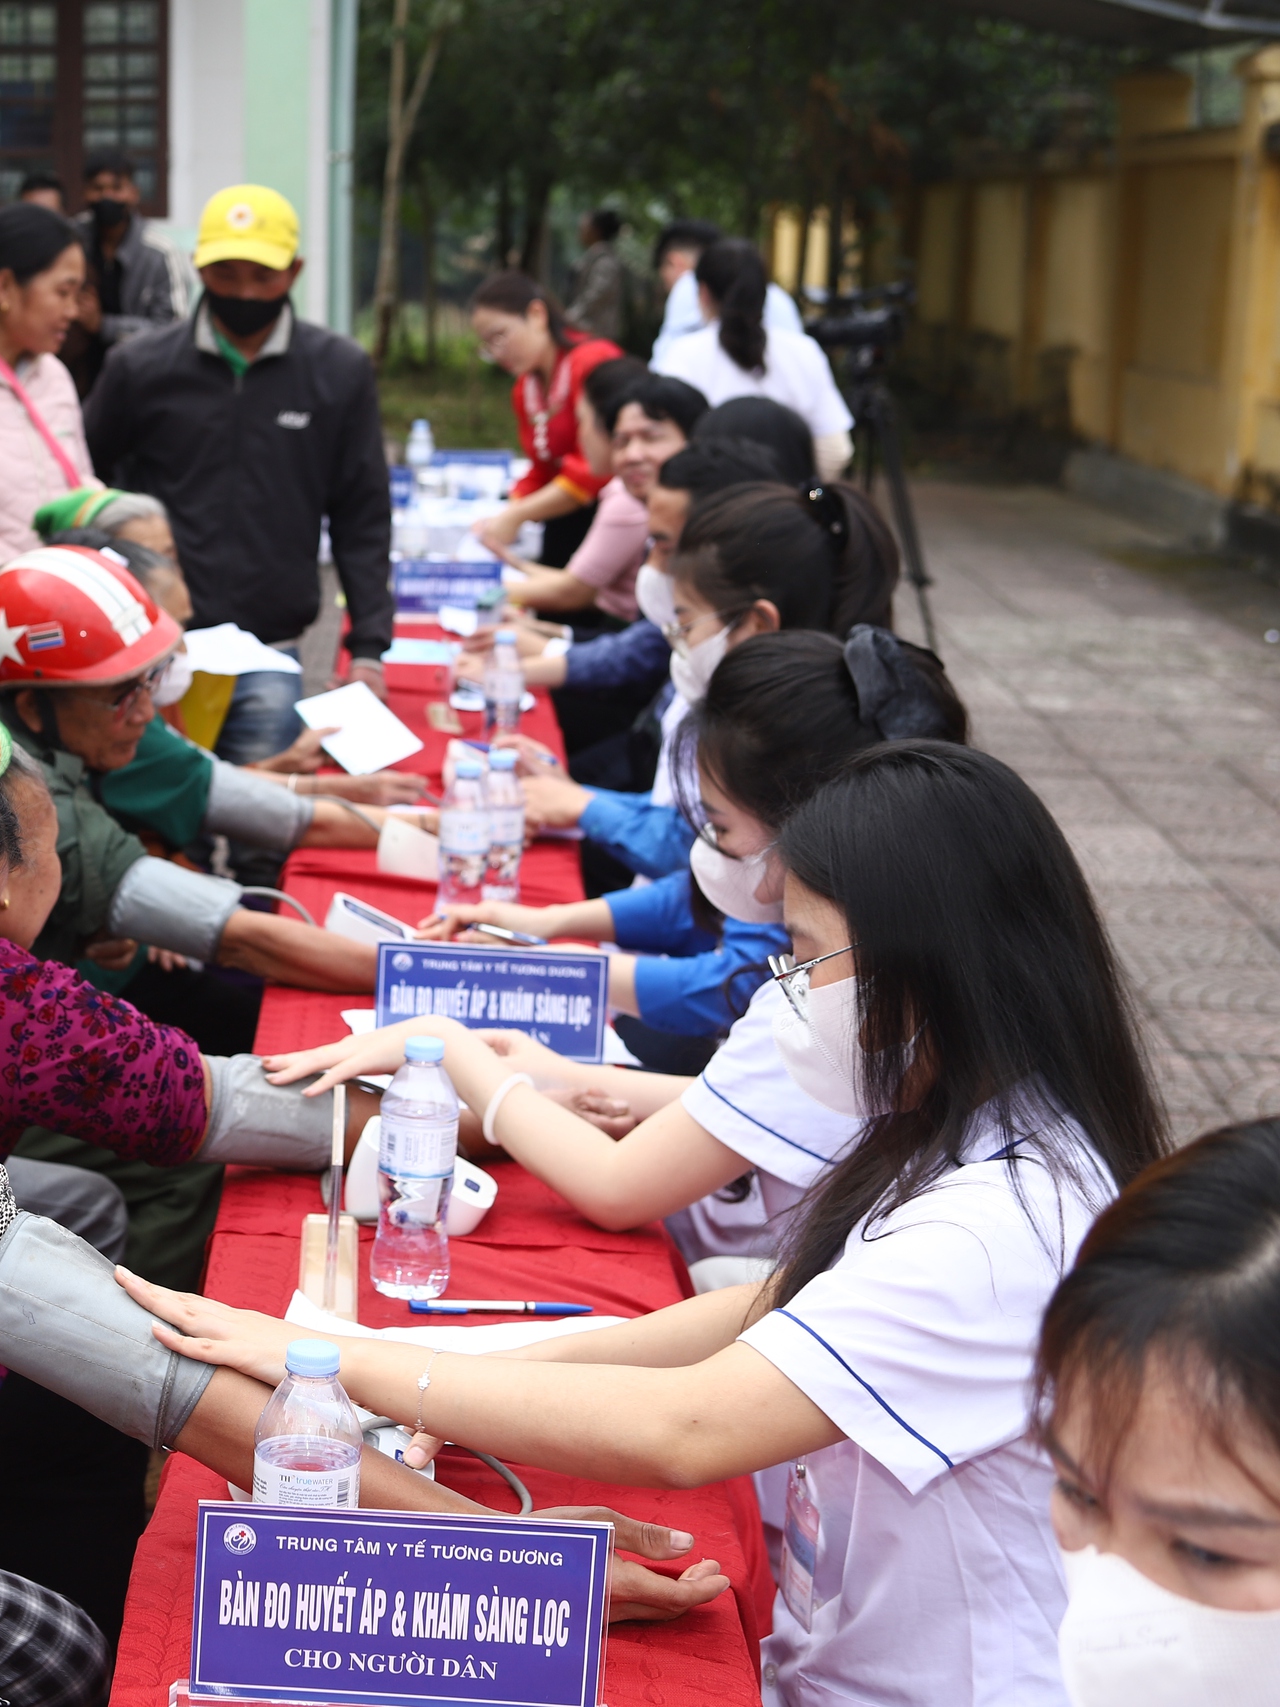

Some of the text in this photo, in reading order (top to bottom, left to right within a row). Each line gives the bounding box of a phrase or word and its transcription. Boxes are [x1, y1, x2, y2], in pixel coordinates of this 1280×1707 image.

[422, 959, 587, 979] TRUNG TÂM Y TẾ TƯƠNG DƯƠNG
[390, 979, 415, 1015] BÀN
[433, 980, 470, 1017] HUYẾT
[470, 981, 487, 1018] ÁP
[488, 990, 498, 1020] &
[499, 982, 535, 1022] KHÁM
[535, 988, 567, 1024] SÀNG
[568, 995, 592, 1031] LỌC
[276, 1536, 338, 1553] TRUNG
[343, 1538, 380, 1556] TÂM
[386, 1542, 399, 1557] Y
[403, 1539, 425, 1558] TẾ
[430, 1543, 493, 1563] TƯƠNG
[499, 1547, 563, 1566] DƯƠNG
[219, 1570, 570, 1657] BÀN ĐO HUYẾT ÁP & KHÁM SÀNG LỌC
[283, 1648, 498, 1680] CHO NGƯỜI DÂN
